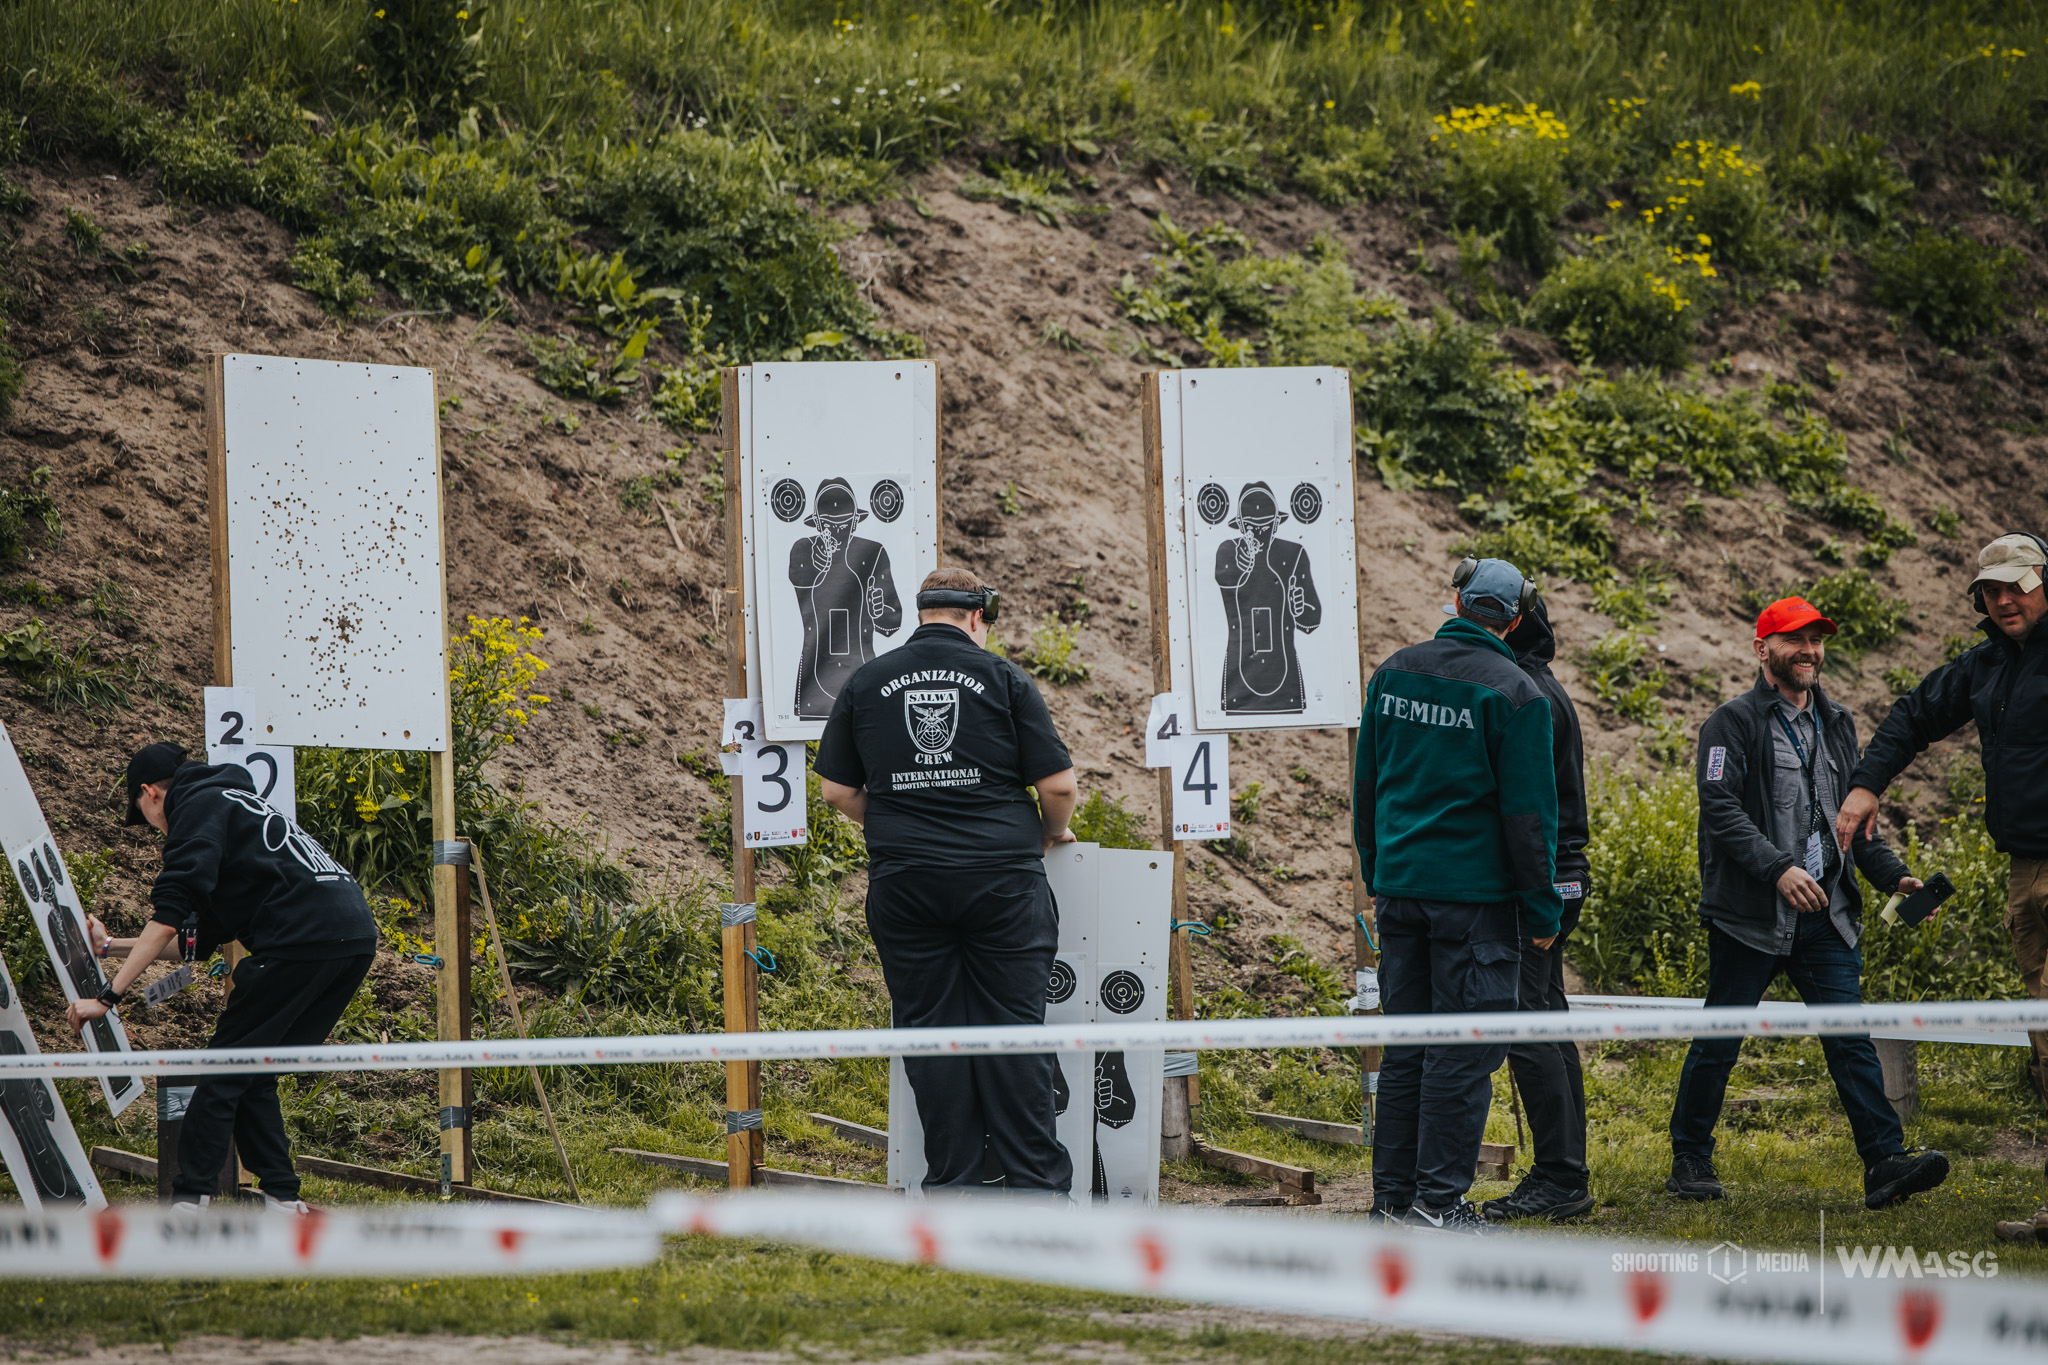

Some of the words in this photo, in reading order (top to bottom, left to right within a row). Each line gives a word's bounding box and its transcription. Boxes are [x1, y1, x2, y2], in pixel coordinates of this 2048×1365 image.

[880, 669, 986, 697] ORGANIZATOR
[909, 693, 955, 702] SALWA
[1380, 692, 1475, 729] TEMIDA
[219, 711, 244, 745] 2
[1157, 713, 1181, 740] 4
[914, 750, 953, 765] CREW
[757, 744, 792, 813] 3
[891, 768, 981, 783] INTERNATIONAL
[892, 781, 930, 791] SHOOTING
[930, 777, 981, 788] COMPETITION
[1183, 741, 1218, 805] 4
